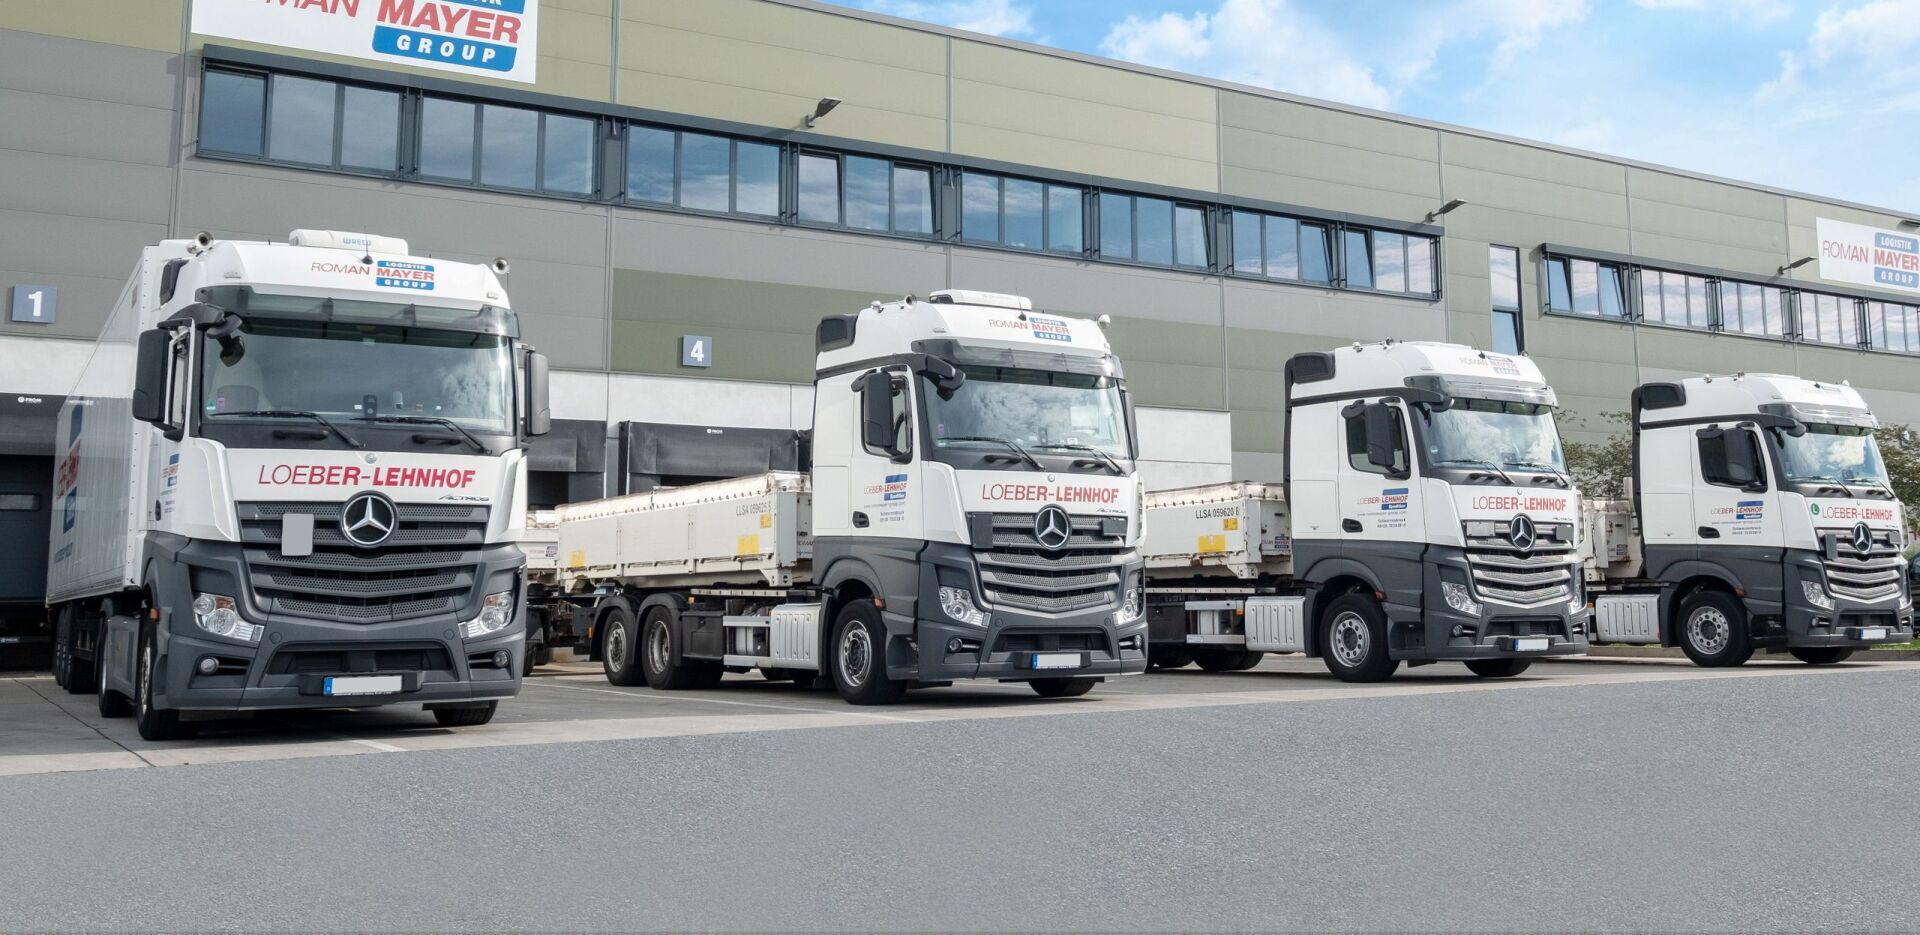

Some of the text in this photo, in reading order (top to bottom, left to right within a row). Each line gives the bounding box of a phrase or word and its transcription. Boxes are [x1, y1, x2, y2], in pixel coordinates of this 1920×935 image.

[376, 0, 521, 43] MAYER
[396, 34, 496, 62] GROUP
[1881, 236, 1912, 250] LOGISTIK
[1822, 240, 1869, 263] ROMAN
[385, 261, 426, 270] LOGISTIK
[1874, 249, 1920, 271] MAYER
[311, 262, 370, 275] ROMAN
[376, 267, 435, 281] MAYER
[384, 279, 427, 288] GROUP
[1881, 271, 1913, 284] GROUP
[28, 290, 43, 317] 1
[988, 319, 1029, 330] ROMAN
[1031, 323, 1070, 334] MAYER
[690, 340, 705, 362] 4
[258, 464, 476, 489] LOEBER-LEHNHOF
[982, 483, 1119, 503] LOEBER-LEHNHOF
[1472, 496, 1567, 512] LOEBER-LEHNHOF
[1195, 508, 1212, 519] LLSA
[1212, 507, 1234, 518] 059620
[1822, 506, 1893, 520] LOEBER-LEHNHOF
